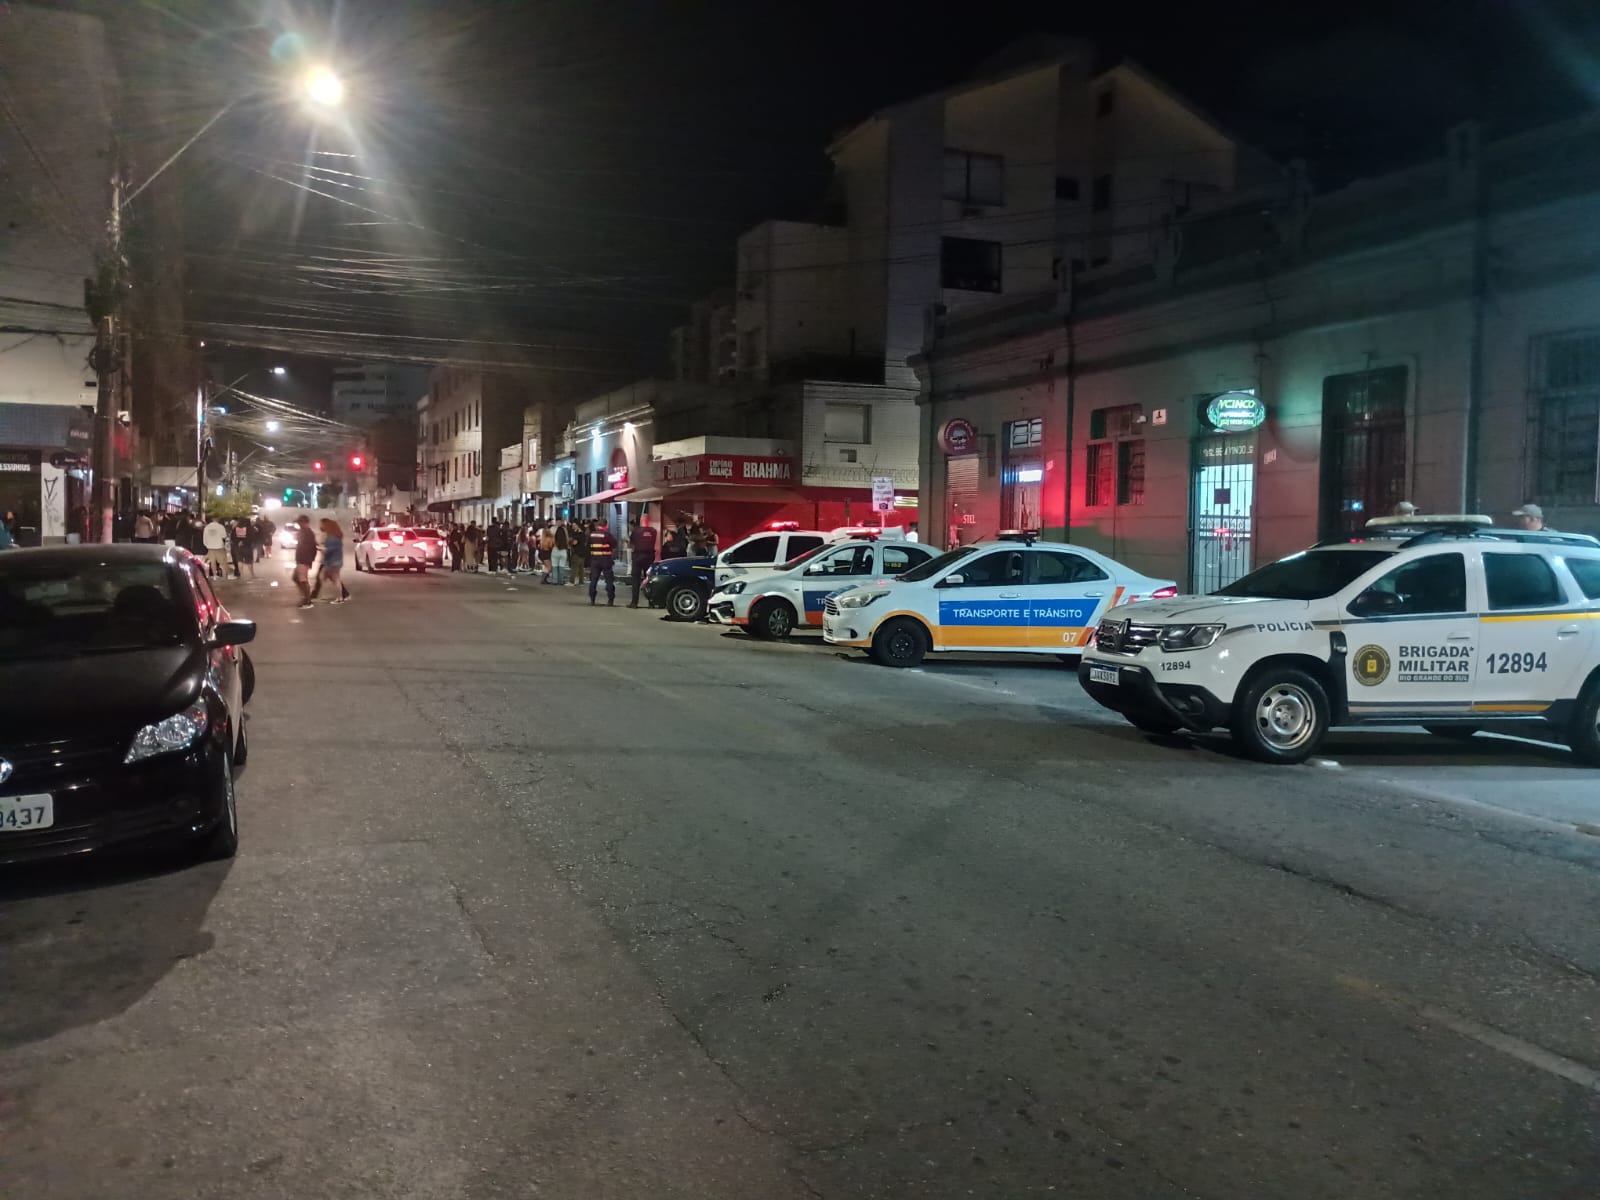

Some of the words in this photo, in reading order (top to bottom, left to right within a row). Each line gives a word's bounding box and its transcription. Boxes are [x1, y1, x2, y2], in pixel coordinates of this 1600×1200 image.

[743, 461, 791, 480] BRAHMA
[953, 608, 1020, 618] TRANSPORTE
[1023, 609, 1030, 618] E
[1033, 607, 1083, 618] TRÂNSITO
[1062, 632, 1077, 643] 07
[1398, 646, 1470, 658] BRIGADA
[1160, 661, 1191, 671] 12894
[1398, 660, 1470, 672] MILITAR
[1486, 651, 1548, 674] 12894
